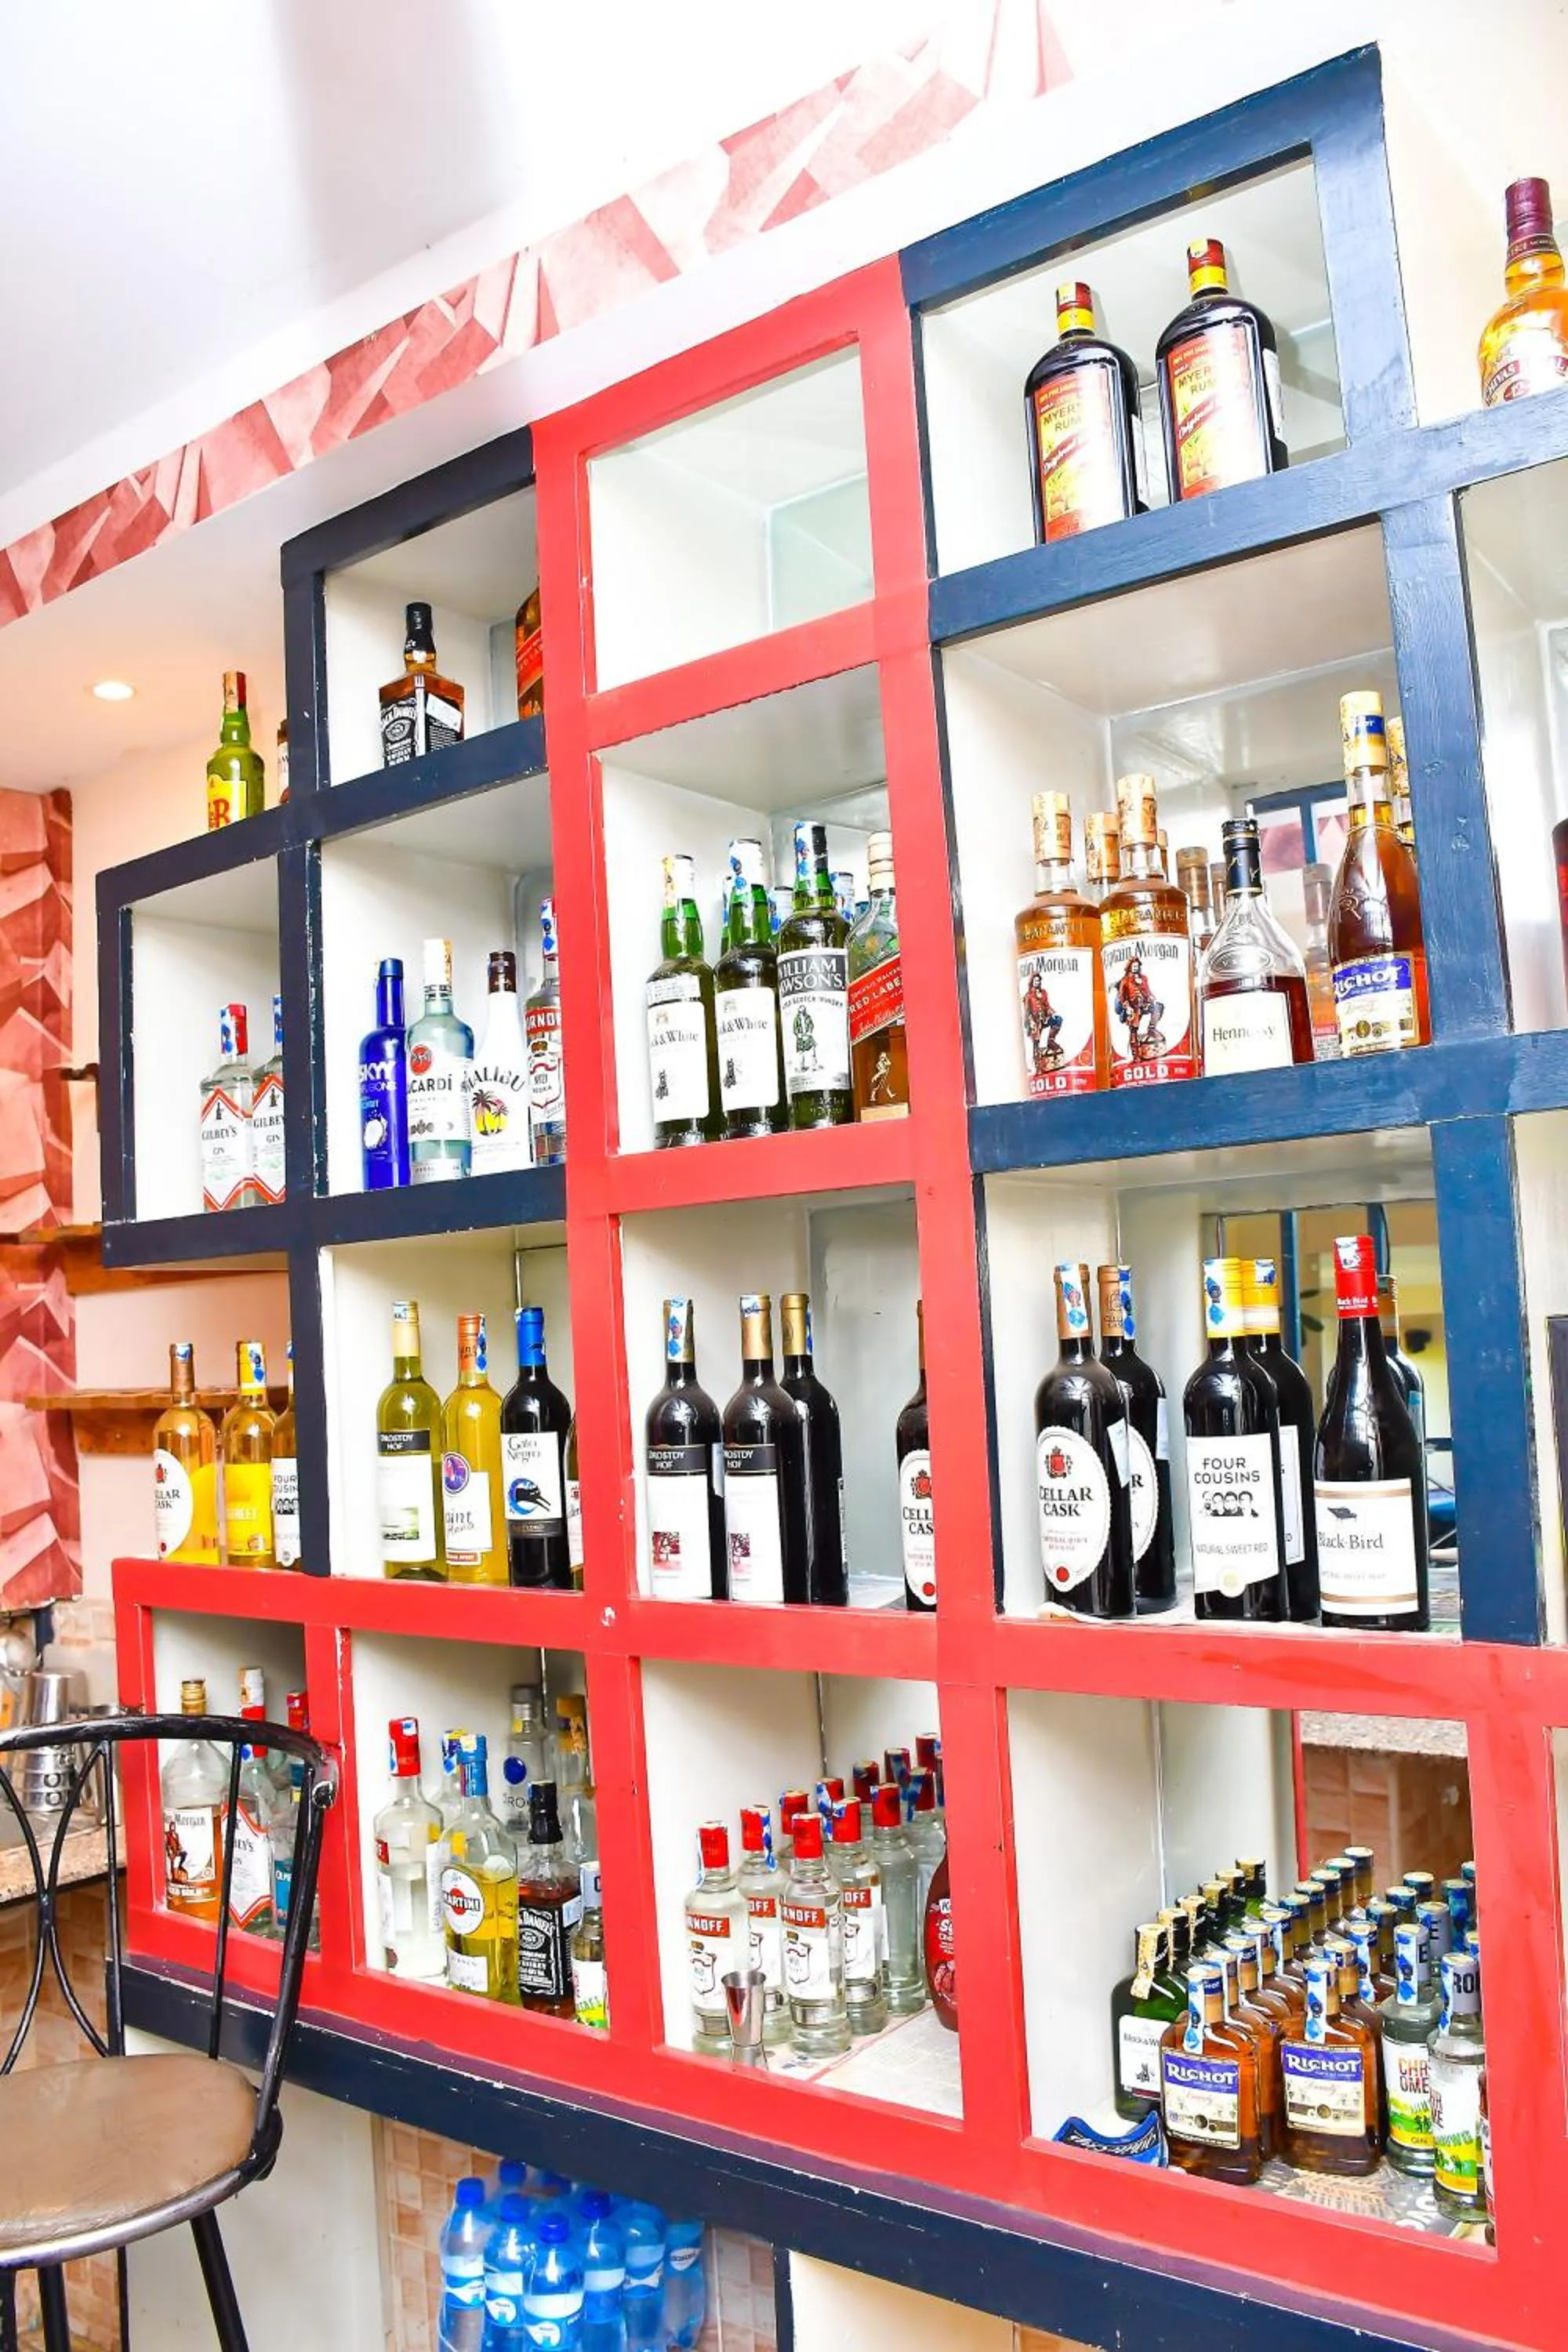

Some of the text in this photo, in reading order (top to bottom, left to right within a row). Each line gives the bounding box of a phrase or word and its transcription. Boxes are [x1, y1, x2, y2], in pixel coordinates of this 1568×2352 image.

[850, 996, 869, 1014] RED
[873, 977, 902, 1000] LABE
[1123, 1064, 1169, 1080] GOLD
[1203, 1457, 1247, 1470] FOUR
[1194, 1470, 1261, 1484] COUSINS
[1039, 1485, 1094, 1501] CELLAR
[903, 1506, 932, 1520] CELL
[1044, 1502, 1080, 1517] CASK
[909, 1522, 935, 1534] CAS
[1348, 1533, 1385, 1550] Bird
[1286, 2053, 1362, 2072] RICHOT
[1166, 2062, 1237, 2085] RICHOT
